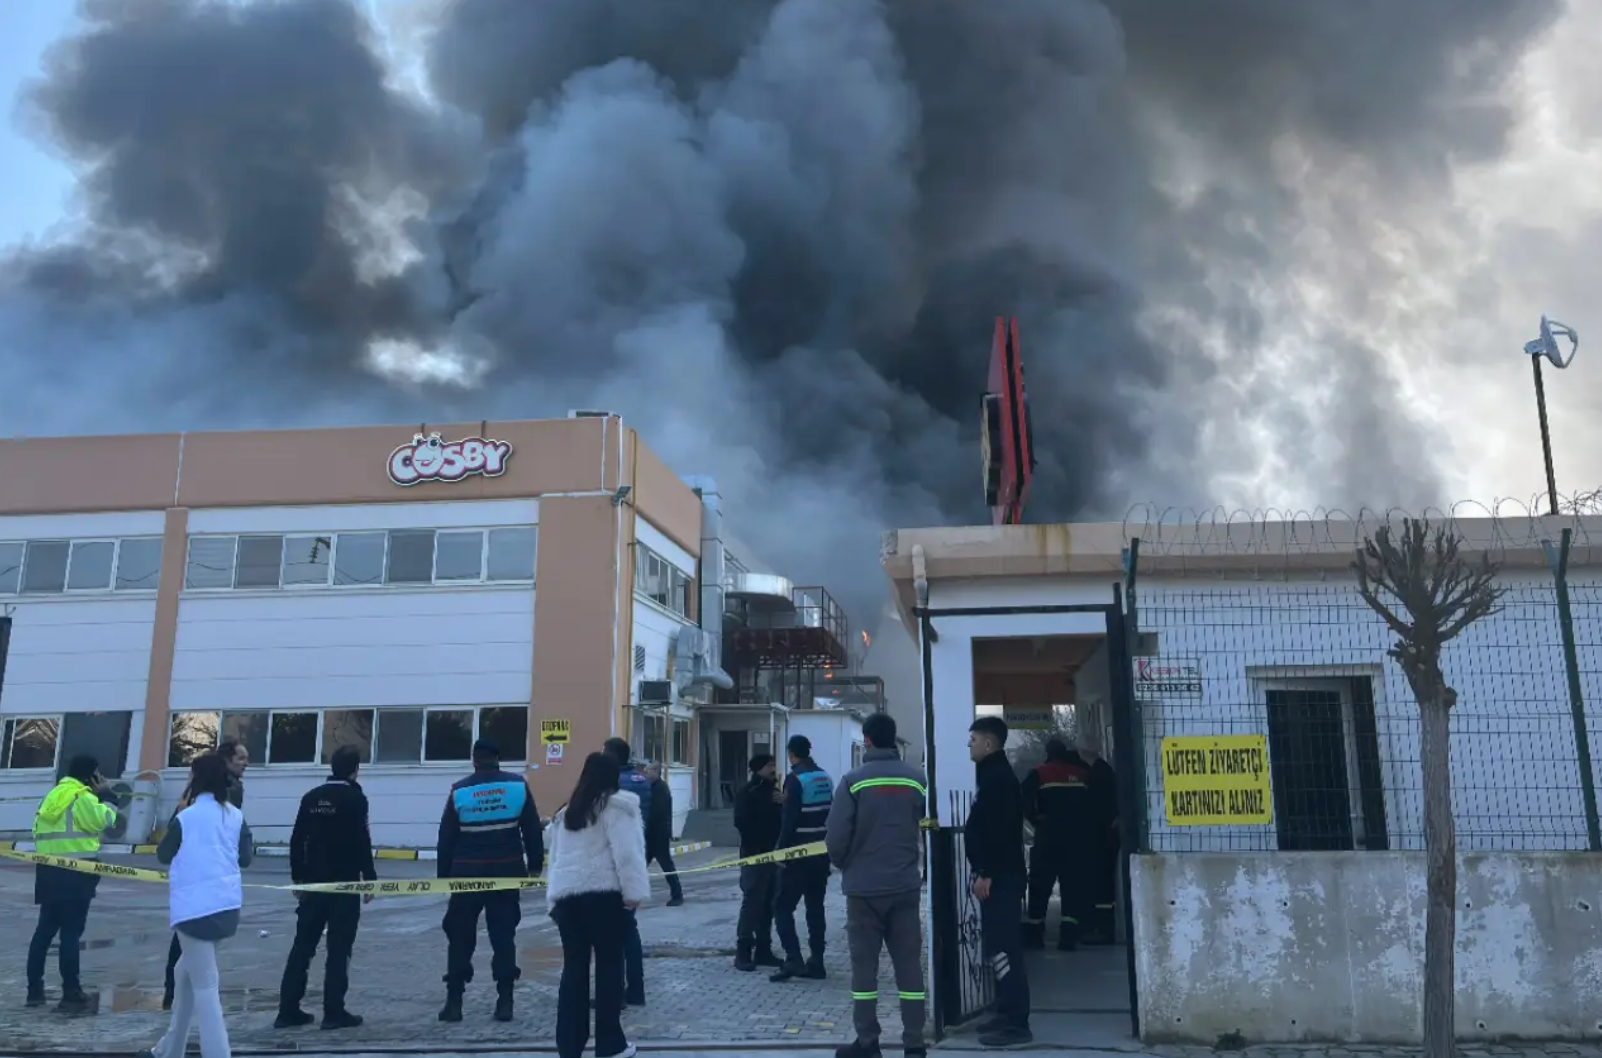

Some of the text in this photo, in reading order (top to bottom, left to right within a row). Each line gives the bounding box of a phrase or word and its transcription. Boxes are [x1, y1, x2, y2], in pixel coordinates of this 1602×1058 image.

[1166, 742, 1263, 781] LÜTFEN ZİYARETÇİ
[1171, 788, 1265, 816] KARTINIZI ALINIZ
